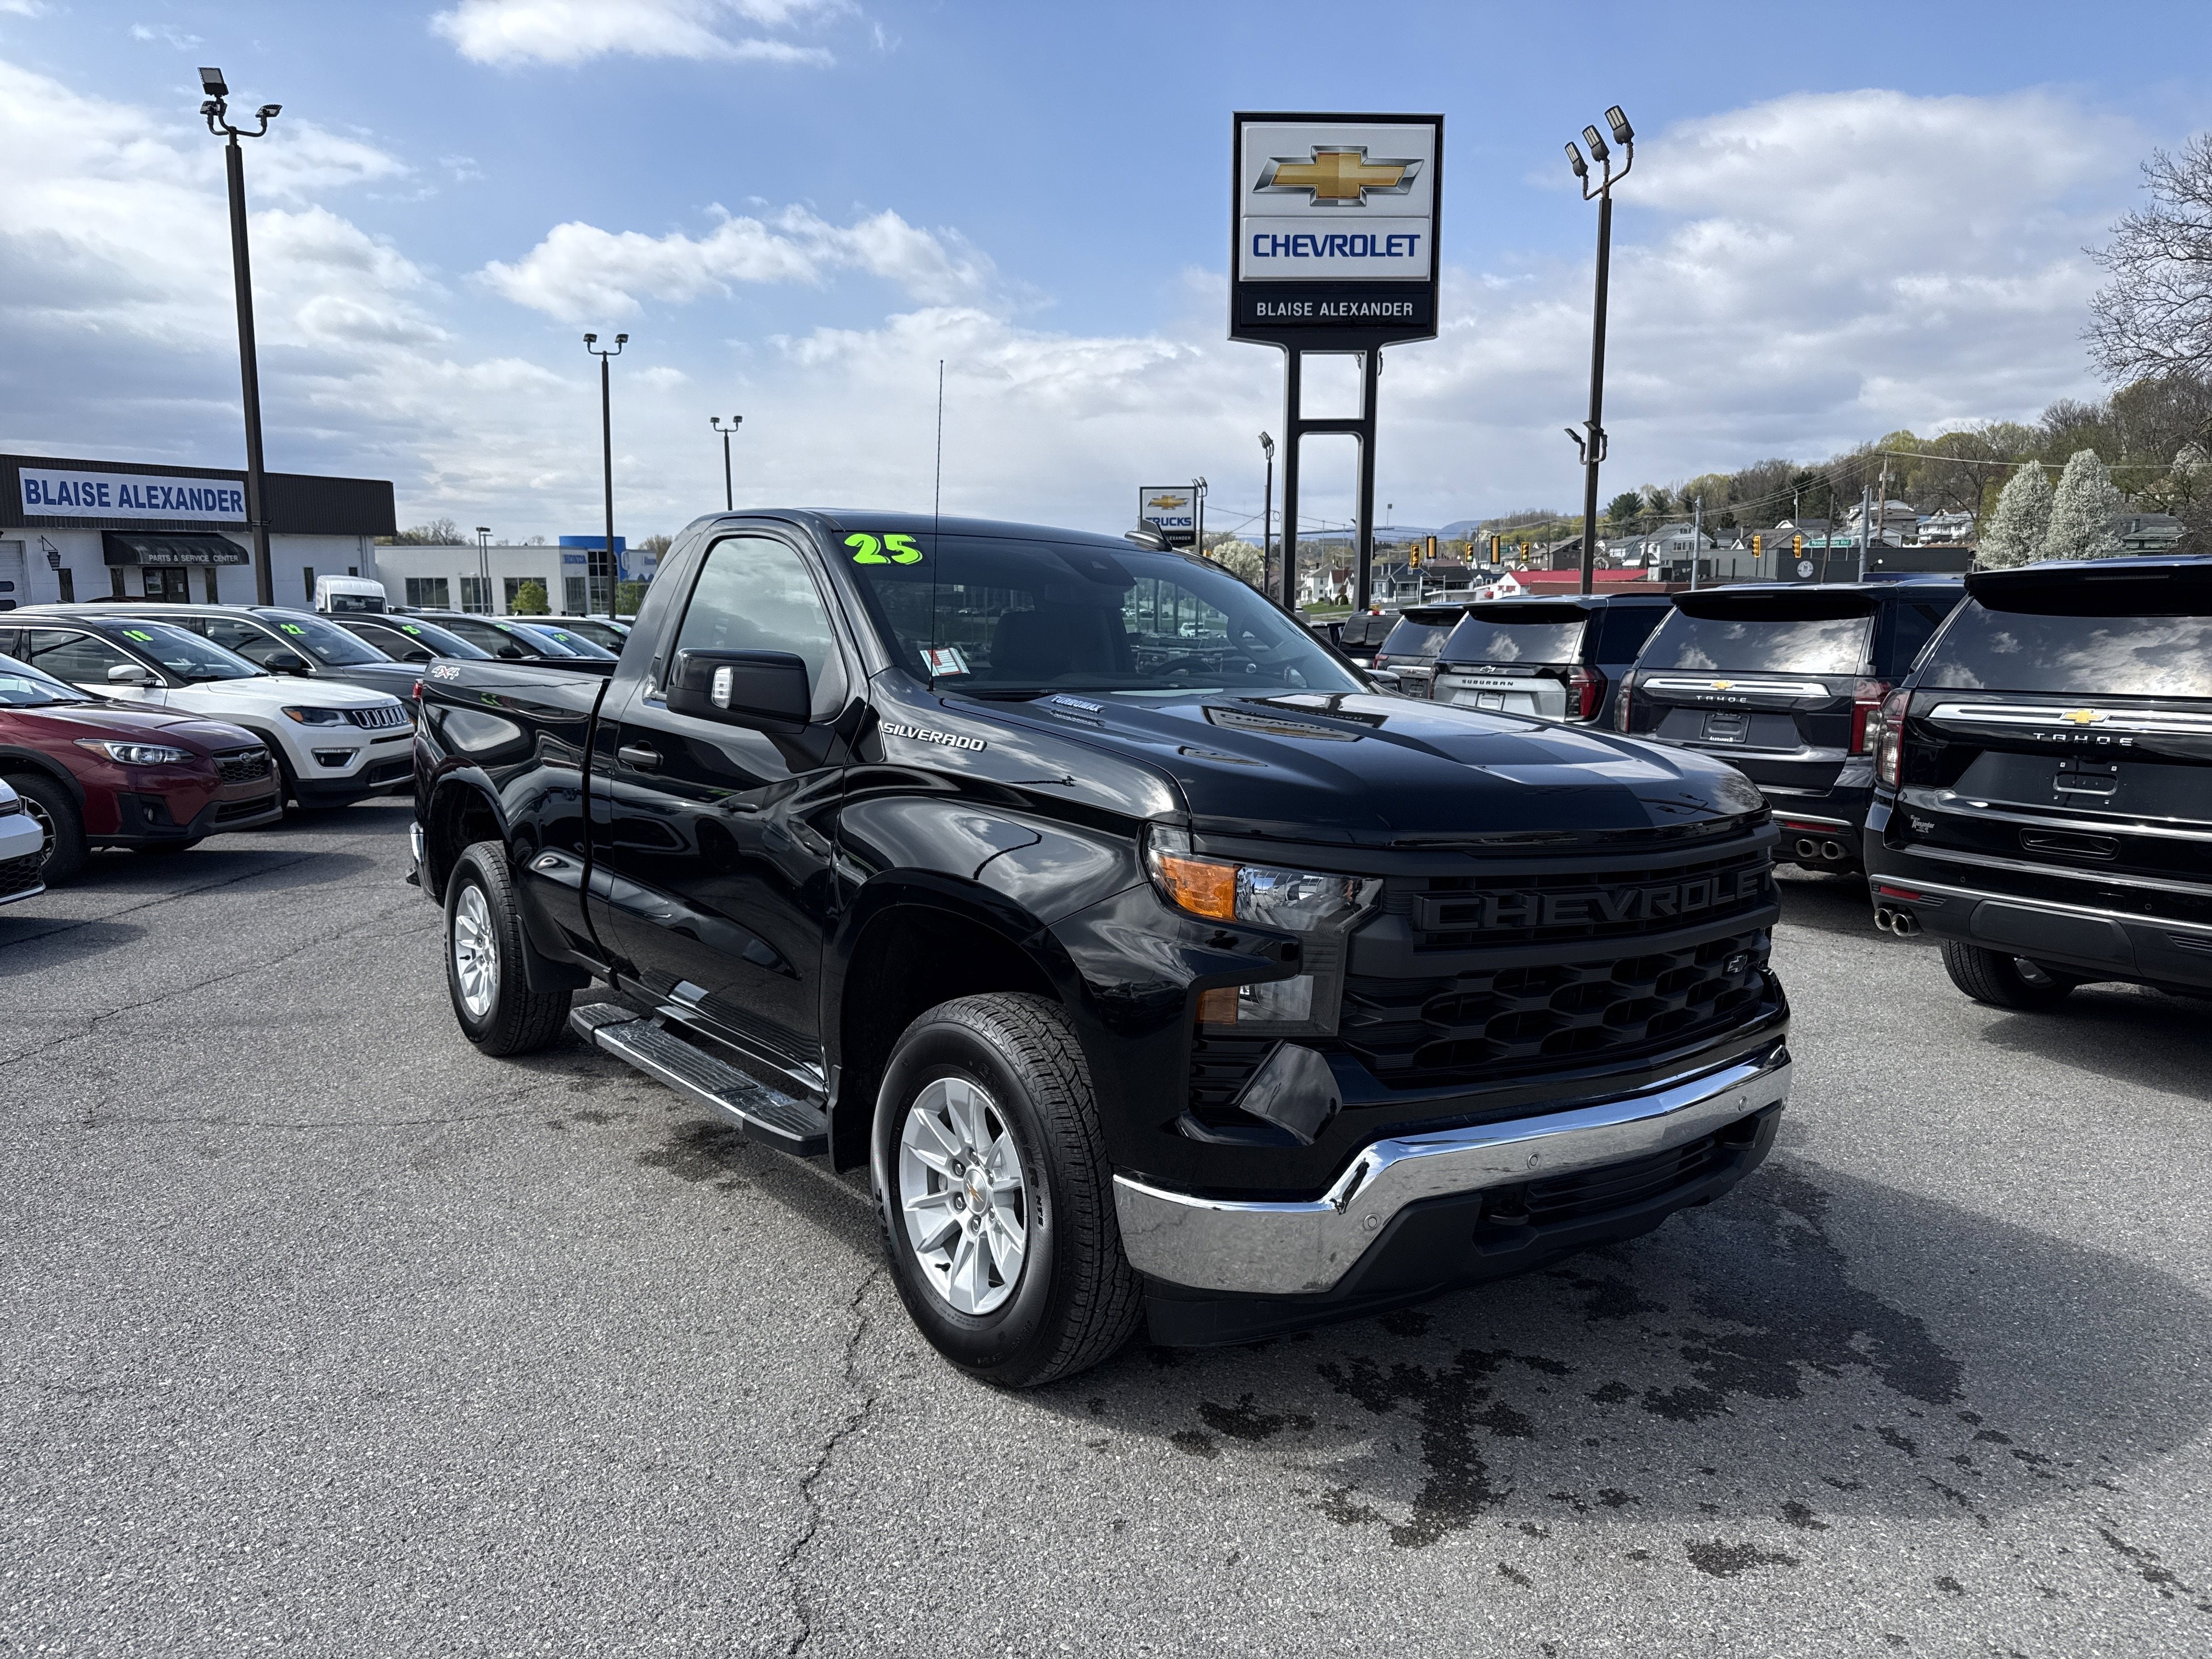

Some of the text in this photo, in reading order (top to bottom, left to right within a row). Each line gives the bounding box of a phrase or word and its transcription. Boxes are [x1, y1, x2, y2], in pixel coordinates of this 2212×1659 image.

[1253, 234, 1421, 257] CHEVROLET
[1256, 302, 1413, 317] BLAISE ALEXANDER
[24, 478, 244, 512] BLAISE ALEXANDER
[844, 533, 923, 565] 25
[122, 630, 154, 642] 18
[1051, 695, 1105, 712] TURBOMAX
[1695, 695, 1747, 703] TAHOE
[883, 723, 988, 753] SILVERADO
[2033, 732, 2134, 746] TAHOE
[1413, 860, 1776, 932] CHEVROLET
